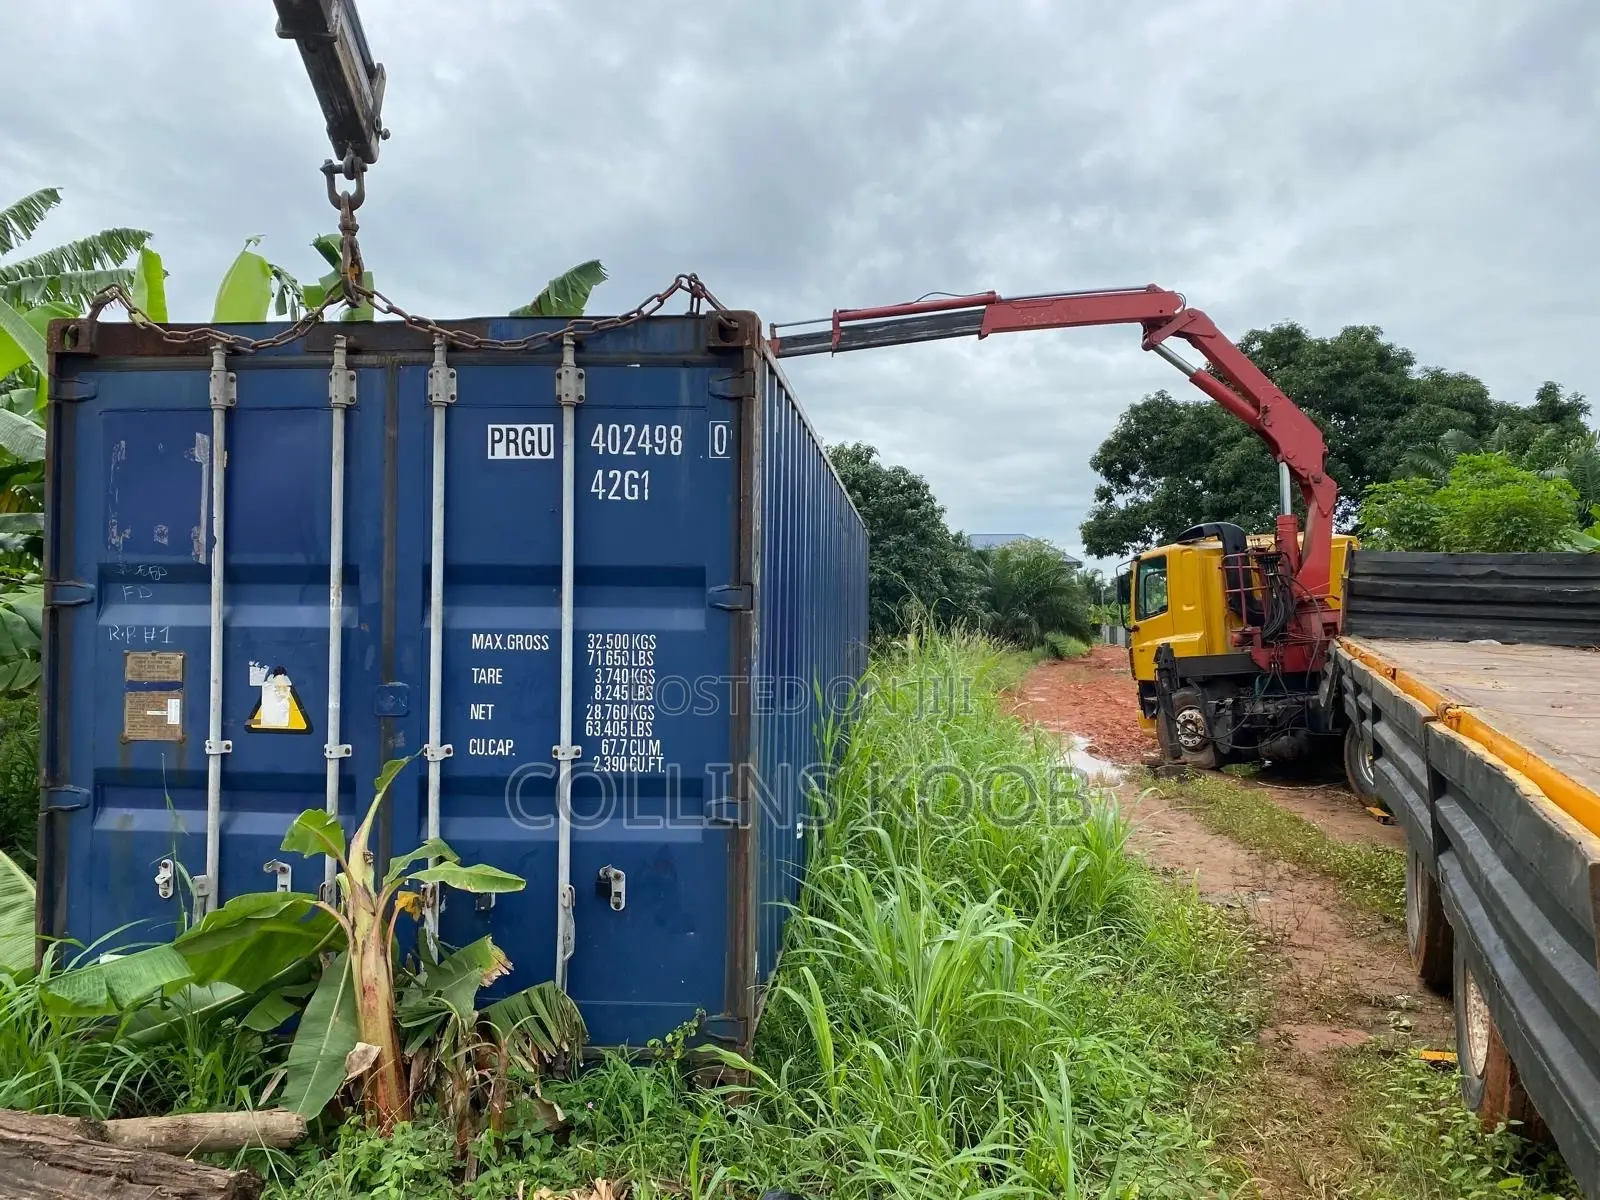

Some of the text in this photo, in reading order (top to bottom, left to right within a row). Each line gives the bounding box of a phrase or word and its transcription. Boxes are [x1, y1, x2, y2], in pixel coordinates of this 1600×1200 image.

[490, 423, 727, 457] PRGU 402498 0
[590, 469, 650, 501] 42G1
[471, 633, 657, 651] MAX.GROSS 32.500 KGS
[587, 650, 654, 666] 71.650 LBS
[471, 667, 656, 685] TARE 3.740 KGS
[594, 684, 653, 701] 8.245 LBS
[470, 703, 655, 721] NET 28.760 KGS
[585, 720, 653, 737] 63.405 LBS
[469, 738, 664, 756] CU.CAP. 67.7 CU.M.
[593, 756, 665, 773] 2.390 CU.FT.
